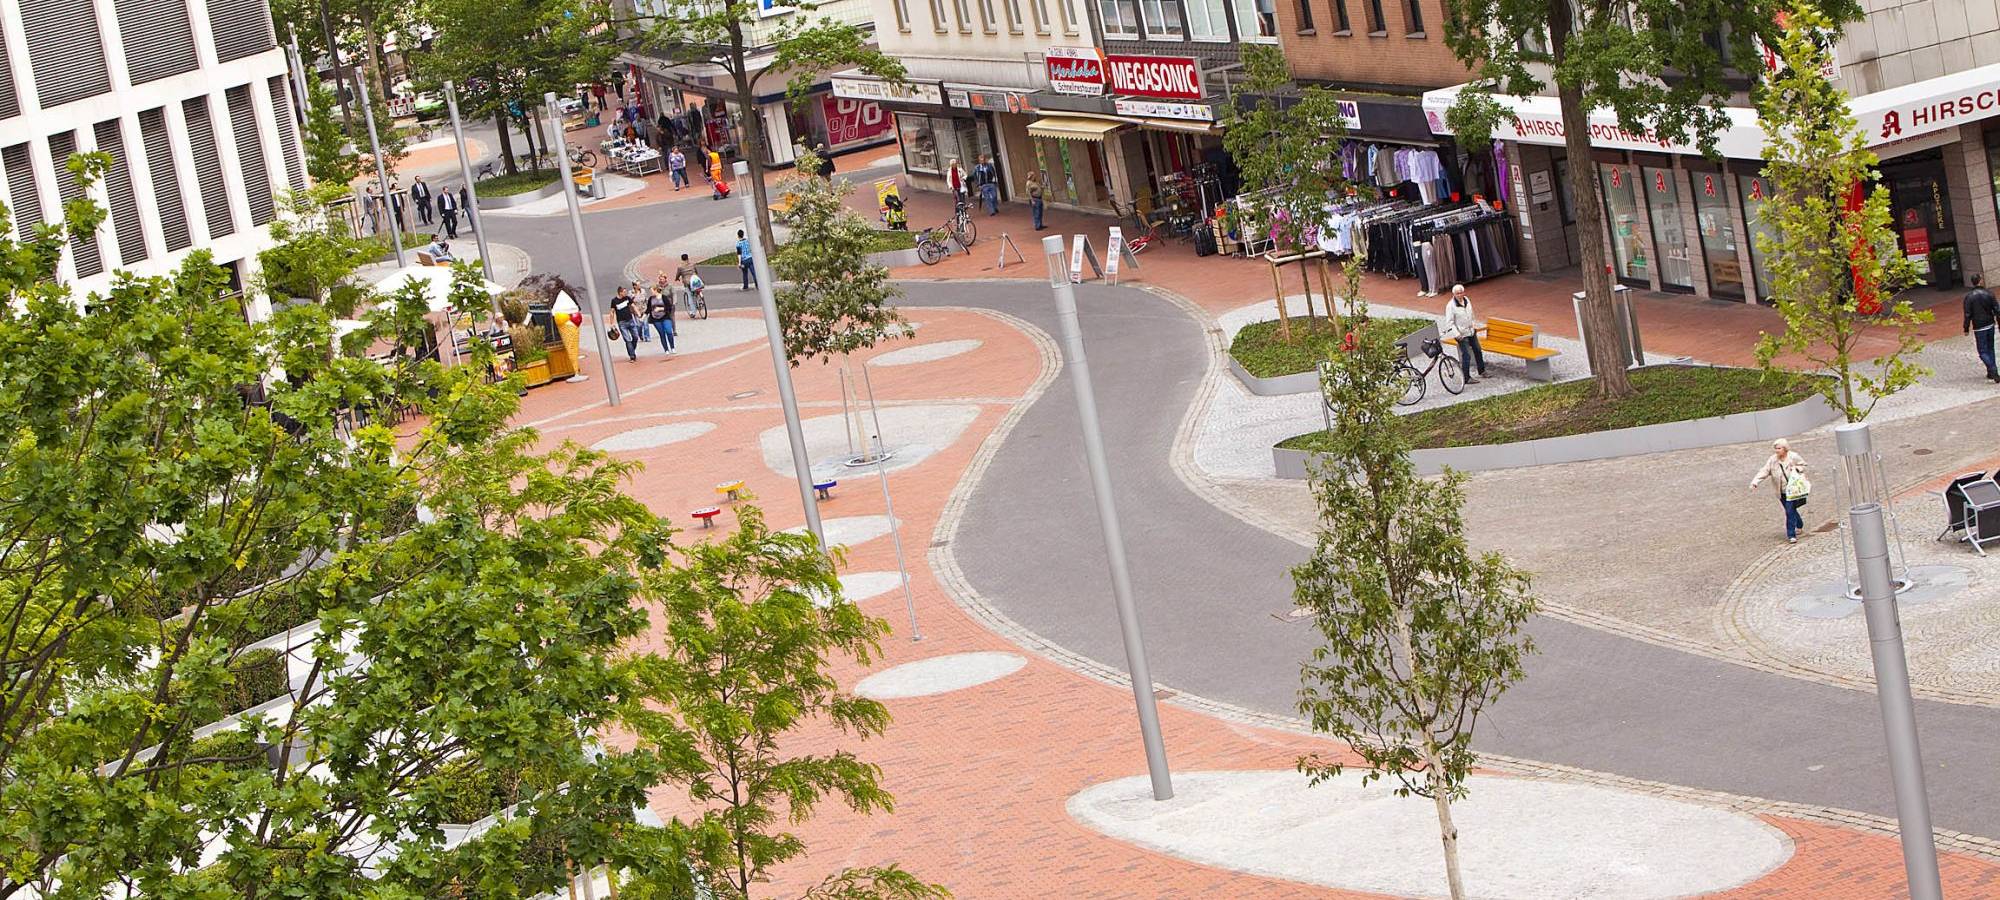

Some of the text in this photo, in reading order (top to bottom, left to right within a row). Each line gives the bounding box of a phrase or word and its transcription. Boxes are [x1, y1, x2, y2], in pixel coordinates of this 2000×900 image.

[1110, 61, 1199, 94] MEGASONIC
[1912, 89, 2000, 127] HIRSC
[1931, 181, 1945, 230] APOTHEKE
